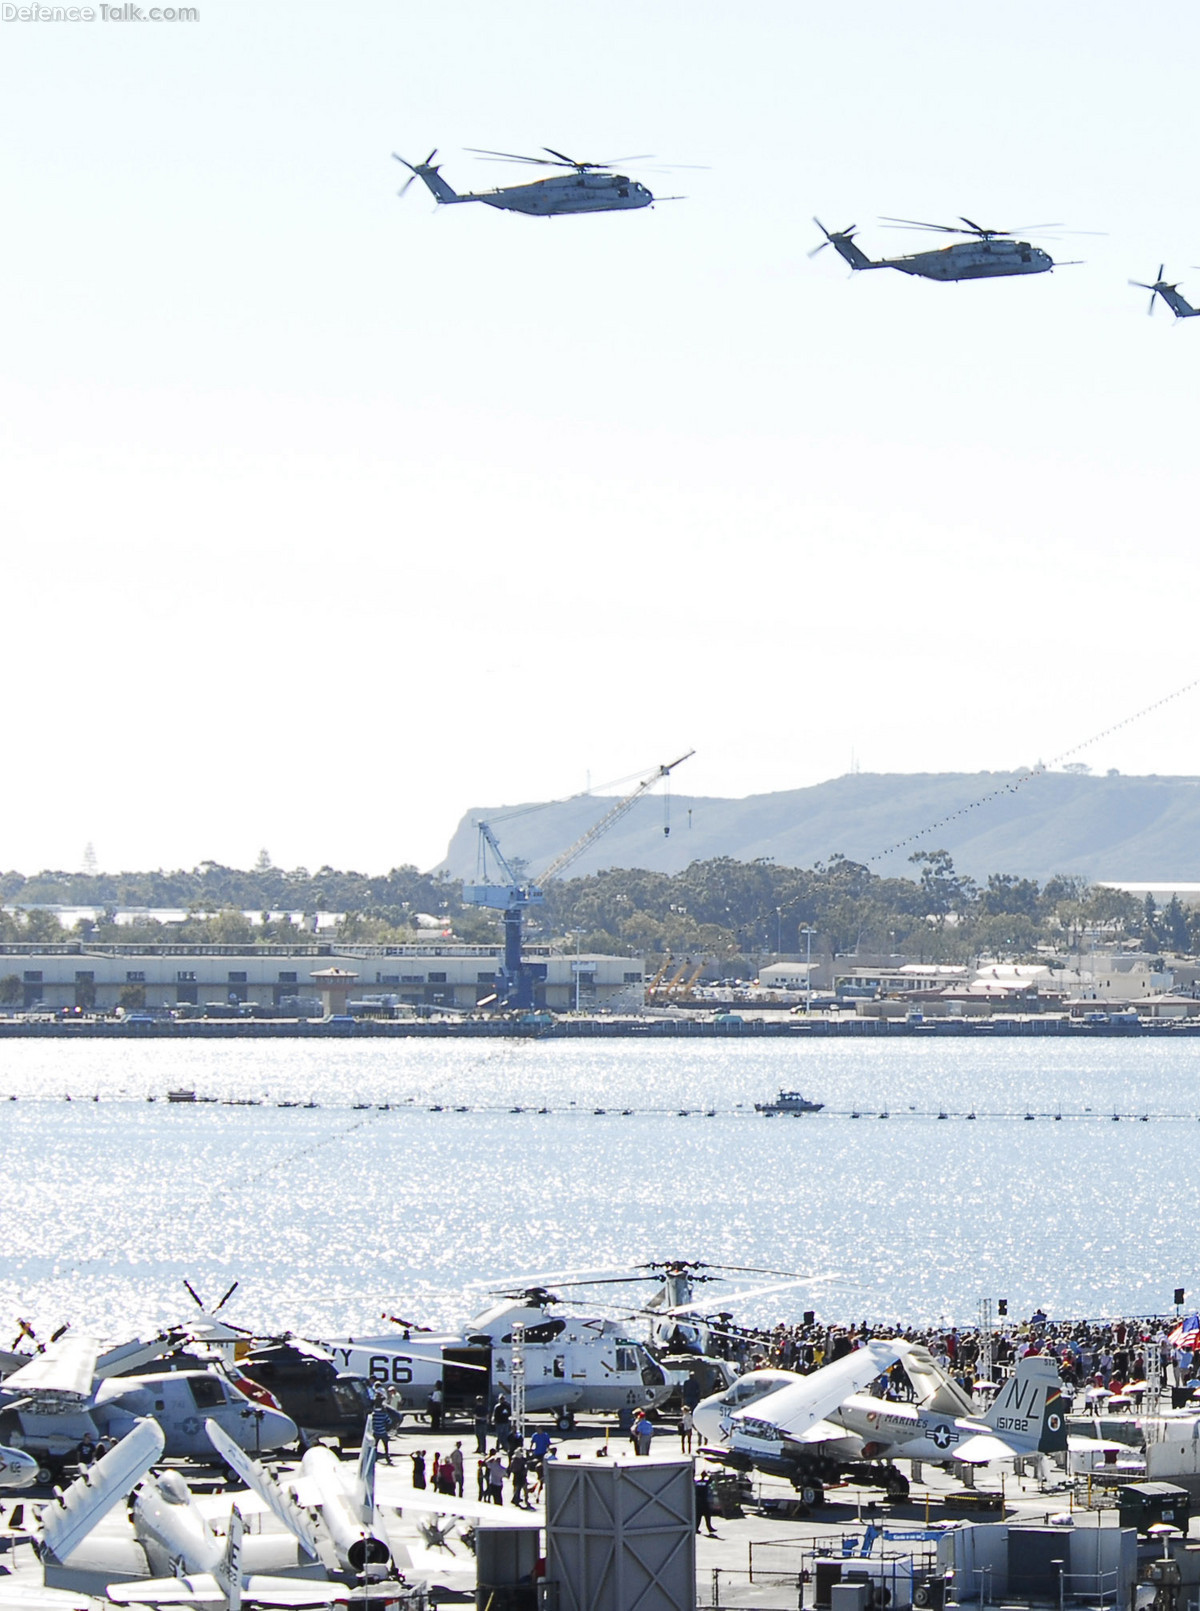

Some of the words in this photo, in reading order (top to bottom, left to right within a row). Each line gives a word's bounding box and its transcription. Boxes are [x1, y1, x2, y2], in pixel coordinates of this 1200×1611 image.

[369, 1356, 412, 1383] 66
[1044, 1359, 1055, 1367] 512
[1005, 1378, 1039, 1419] NL
[719, 1406, 732, 1417] 512
[885, 1414, 928, 1429] MARINES
[996, 1417, 1028, 1431] 151782
